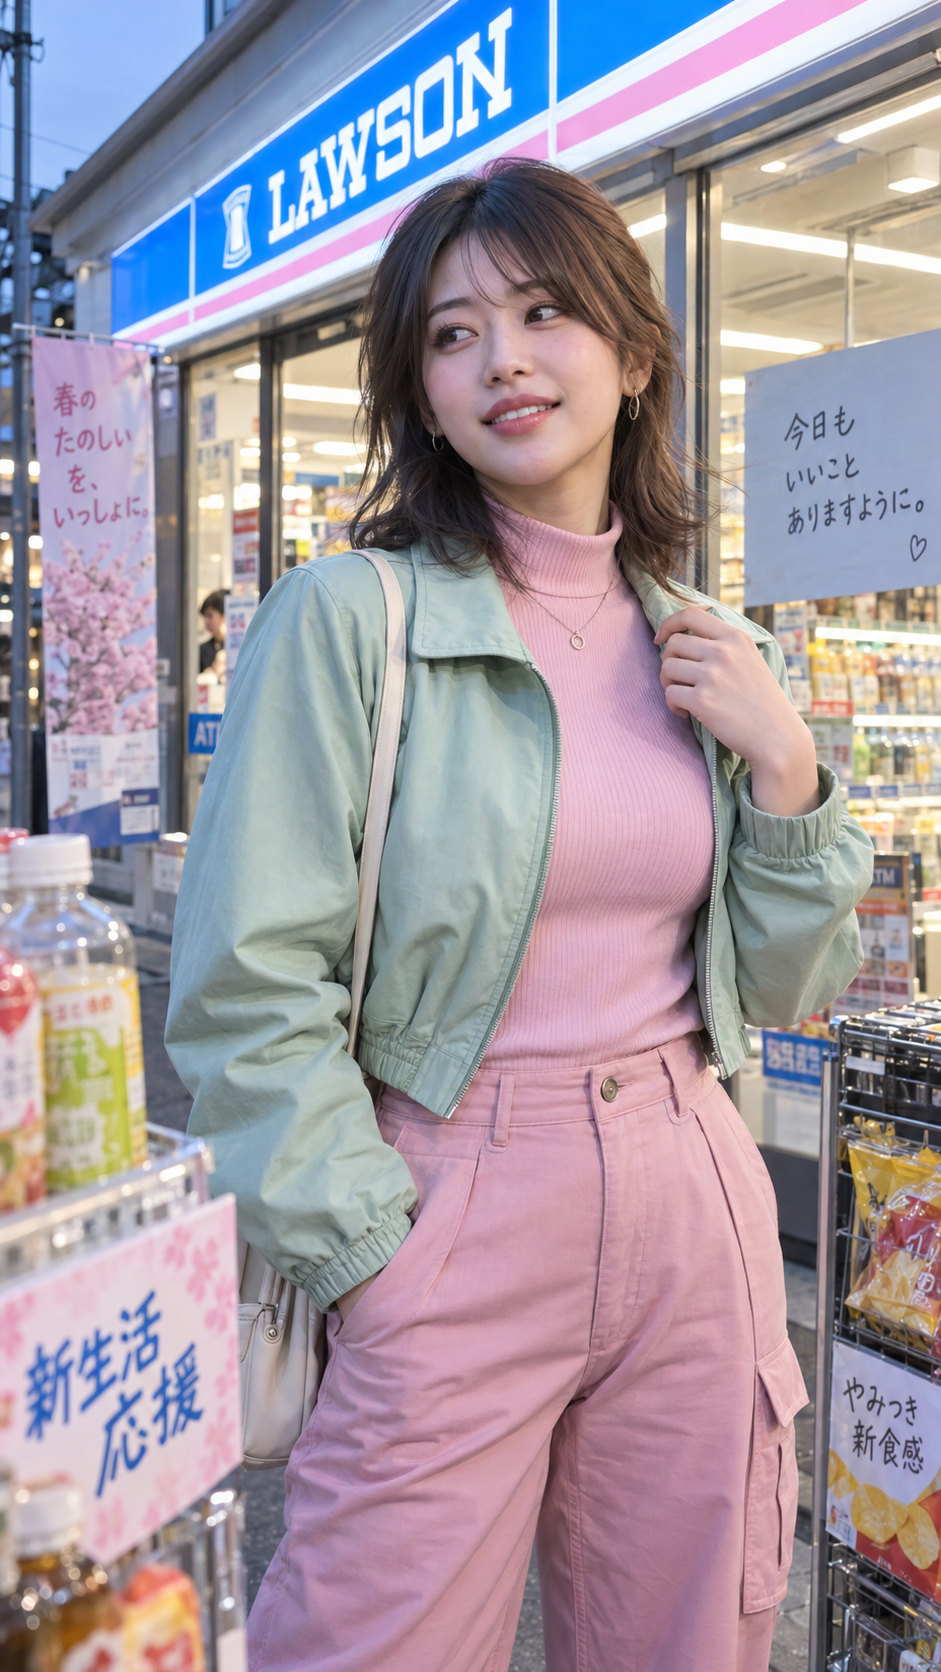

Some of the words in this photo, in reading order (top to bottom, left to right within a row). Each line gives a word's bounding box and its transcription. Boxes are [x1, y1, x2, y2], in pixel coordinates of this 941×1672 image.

[268, 7, 512, 245] LAWSON
[53, 382, 97, 417] 春の
[54, 425, 132, 457] たのしい
[784, 405, 855, 451] 今日も
[67, 464, 98, 493] を、
[786, 453, 860, 492] いいこと
[53, 496, 149, 528] いっしょに。
[787, 487, 924, 535] ありますように。
[873, 868, 896, 885] TM
[26, 1290, 161, 1441] 新生活
[95, 1343, 203, 1497] 応援
[843, 1376, 918, 1426] やみつき
[852, 1419, 924, 1475] 新食感
